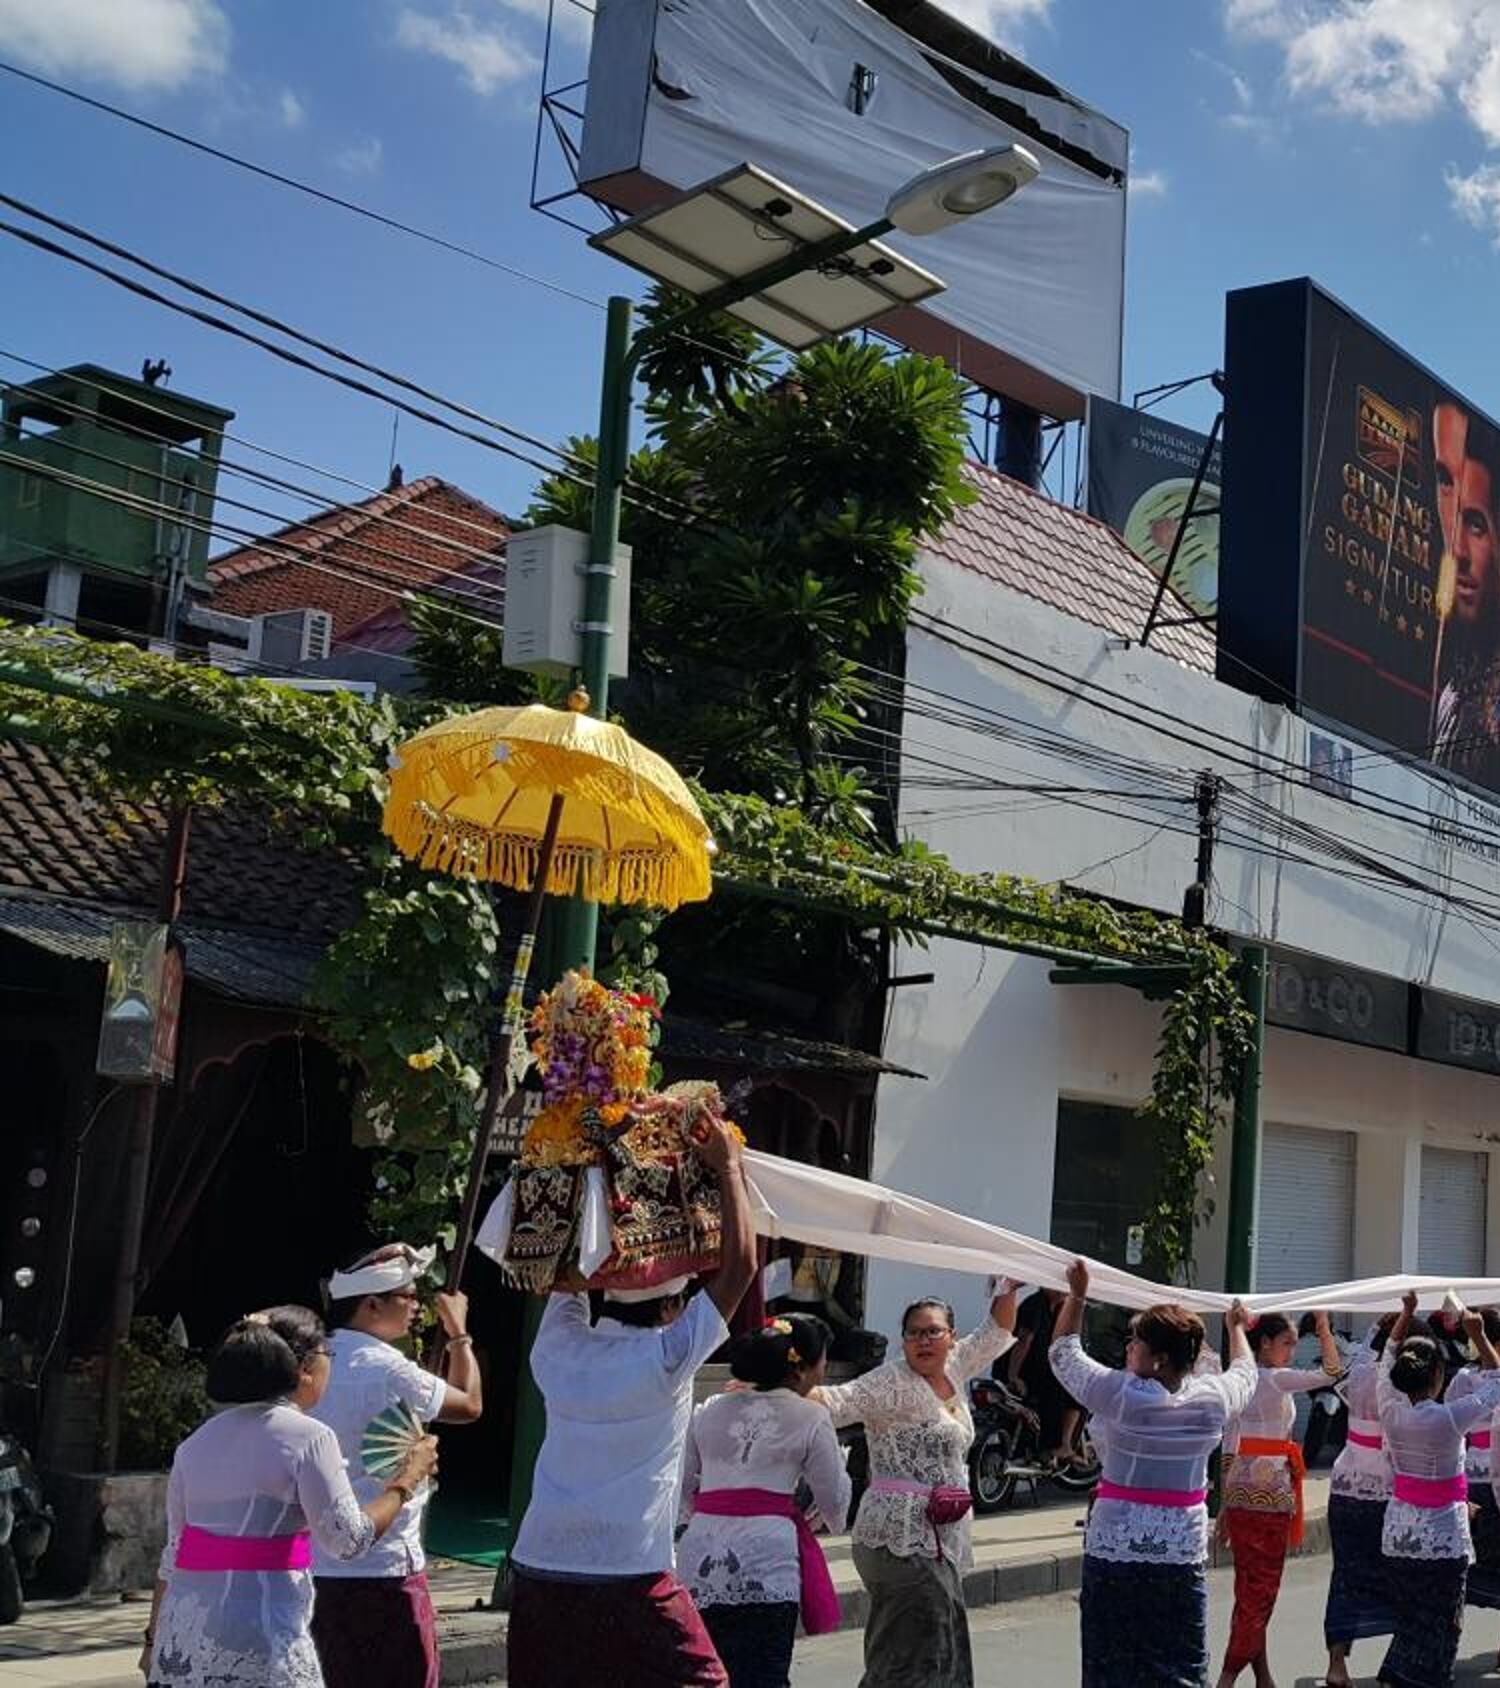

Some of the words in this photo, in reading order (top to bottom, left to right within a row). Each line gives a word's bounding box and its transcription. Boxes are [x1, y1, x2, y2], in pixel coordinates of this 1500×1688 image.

[1342, 493, 1431, 571] GARAM
[1343, 463, 1431, 533] GUDANG
[1325, 525, 1433, 614] SIGNATUR
